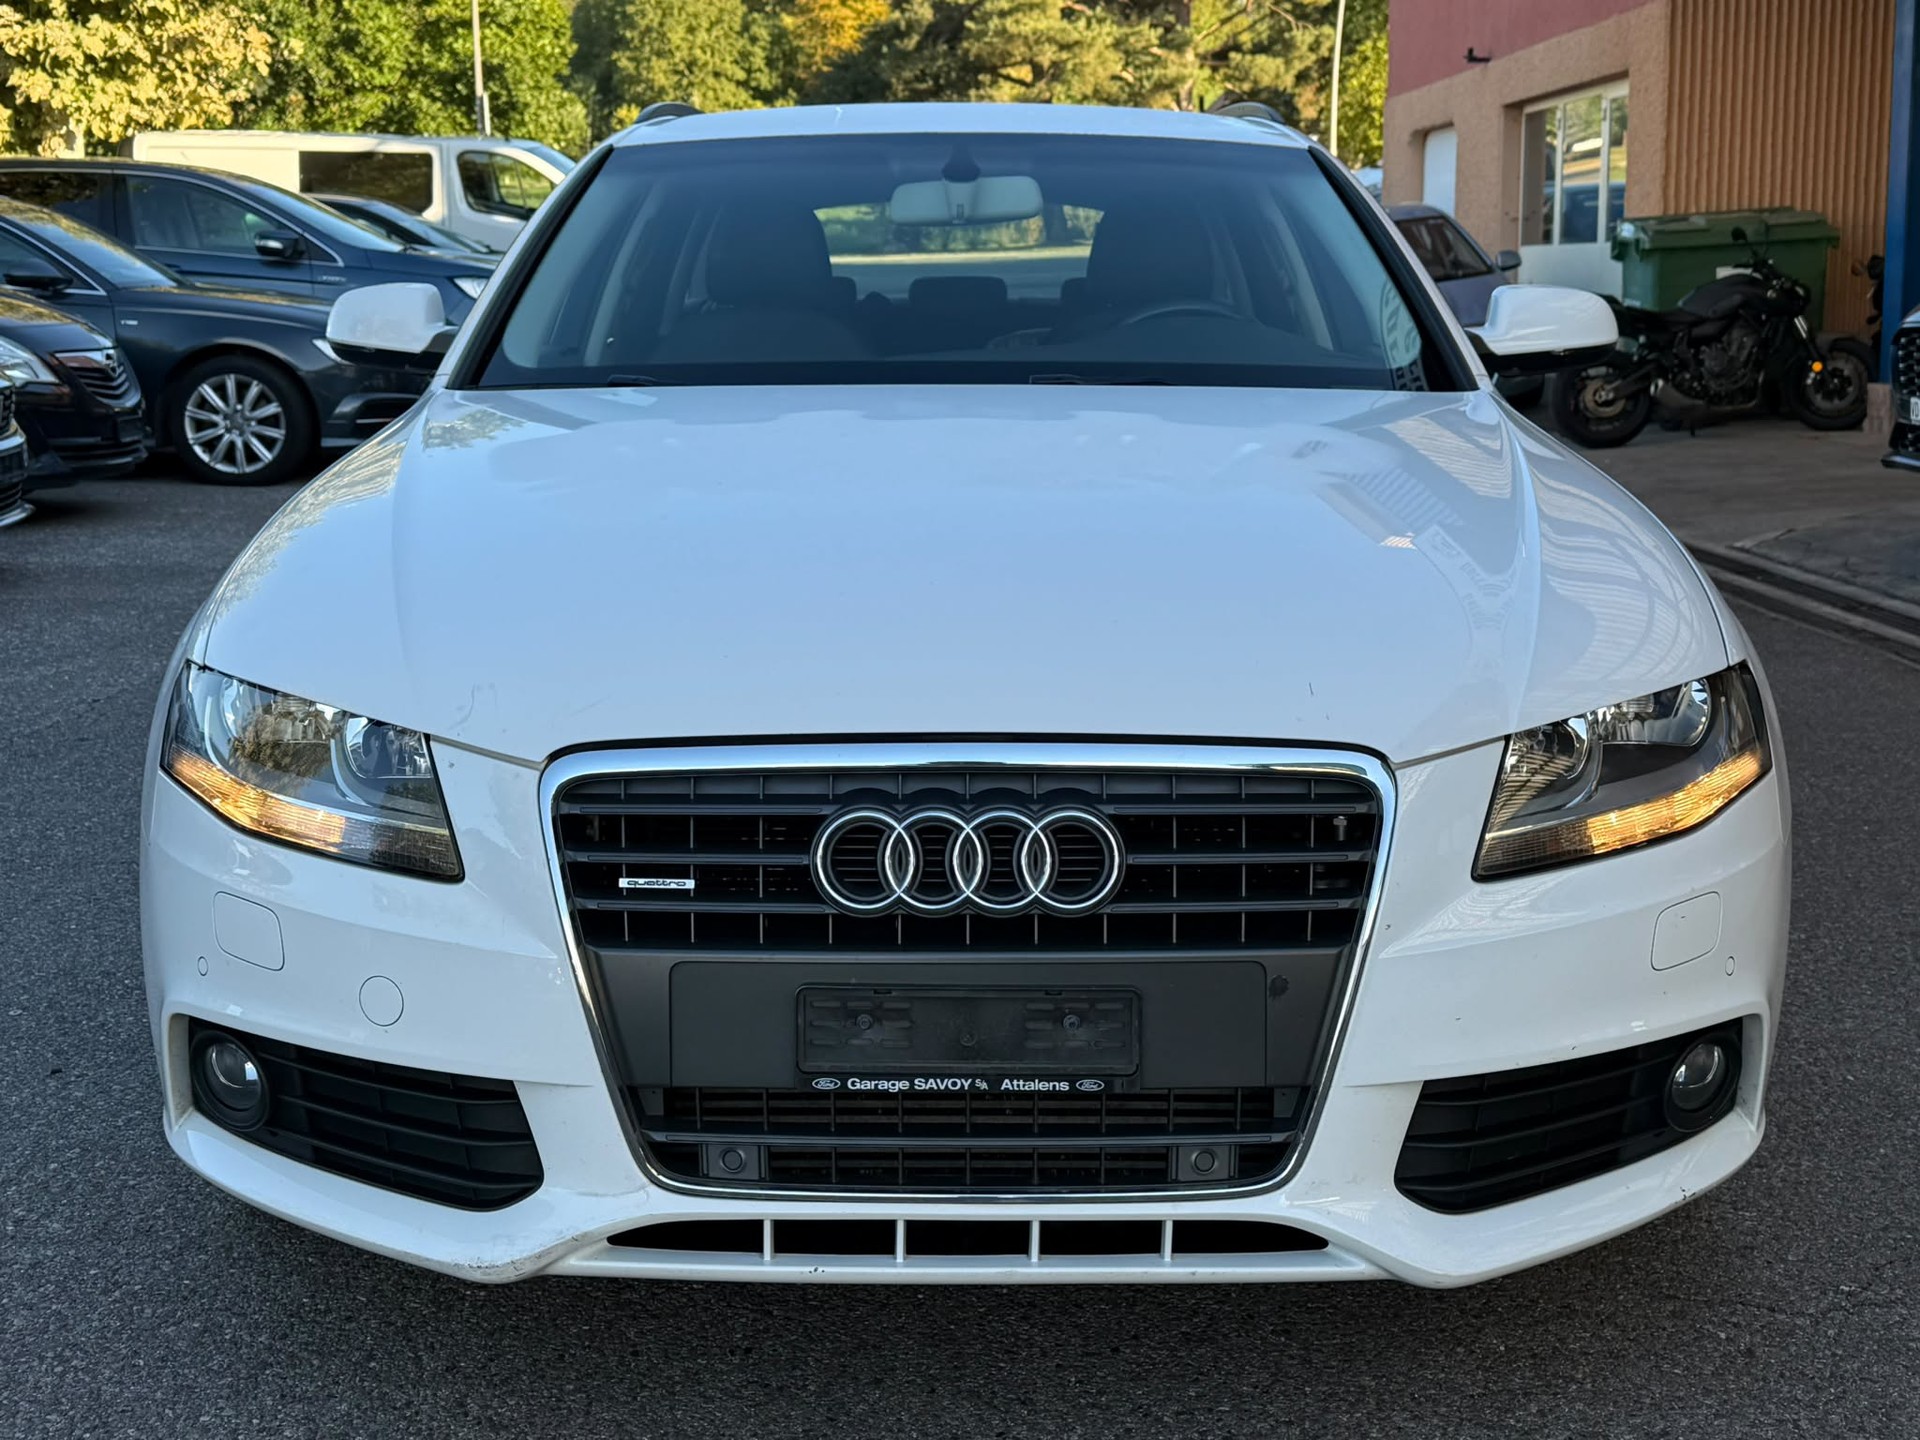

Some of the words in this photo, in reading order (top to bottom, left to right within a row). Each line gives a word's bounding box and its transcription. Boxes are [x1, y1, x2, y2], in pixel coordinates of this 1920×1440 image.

[626, 879, 688, 889] quattro
[847, 1077, 910, 1092] Garage
[914, 1078, 972, 1090] SAVOY
[1000, 1078, 1070, 1091] Attalens
